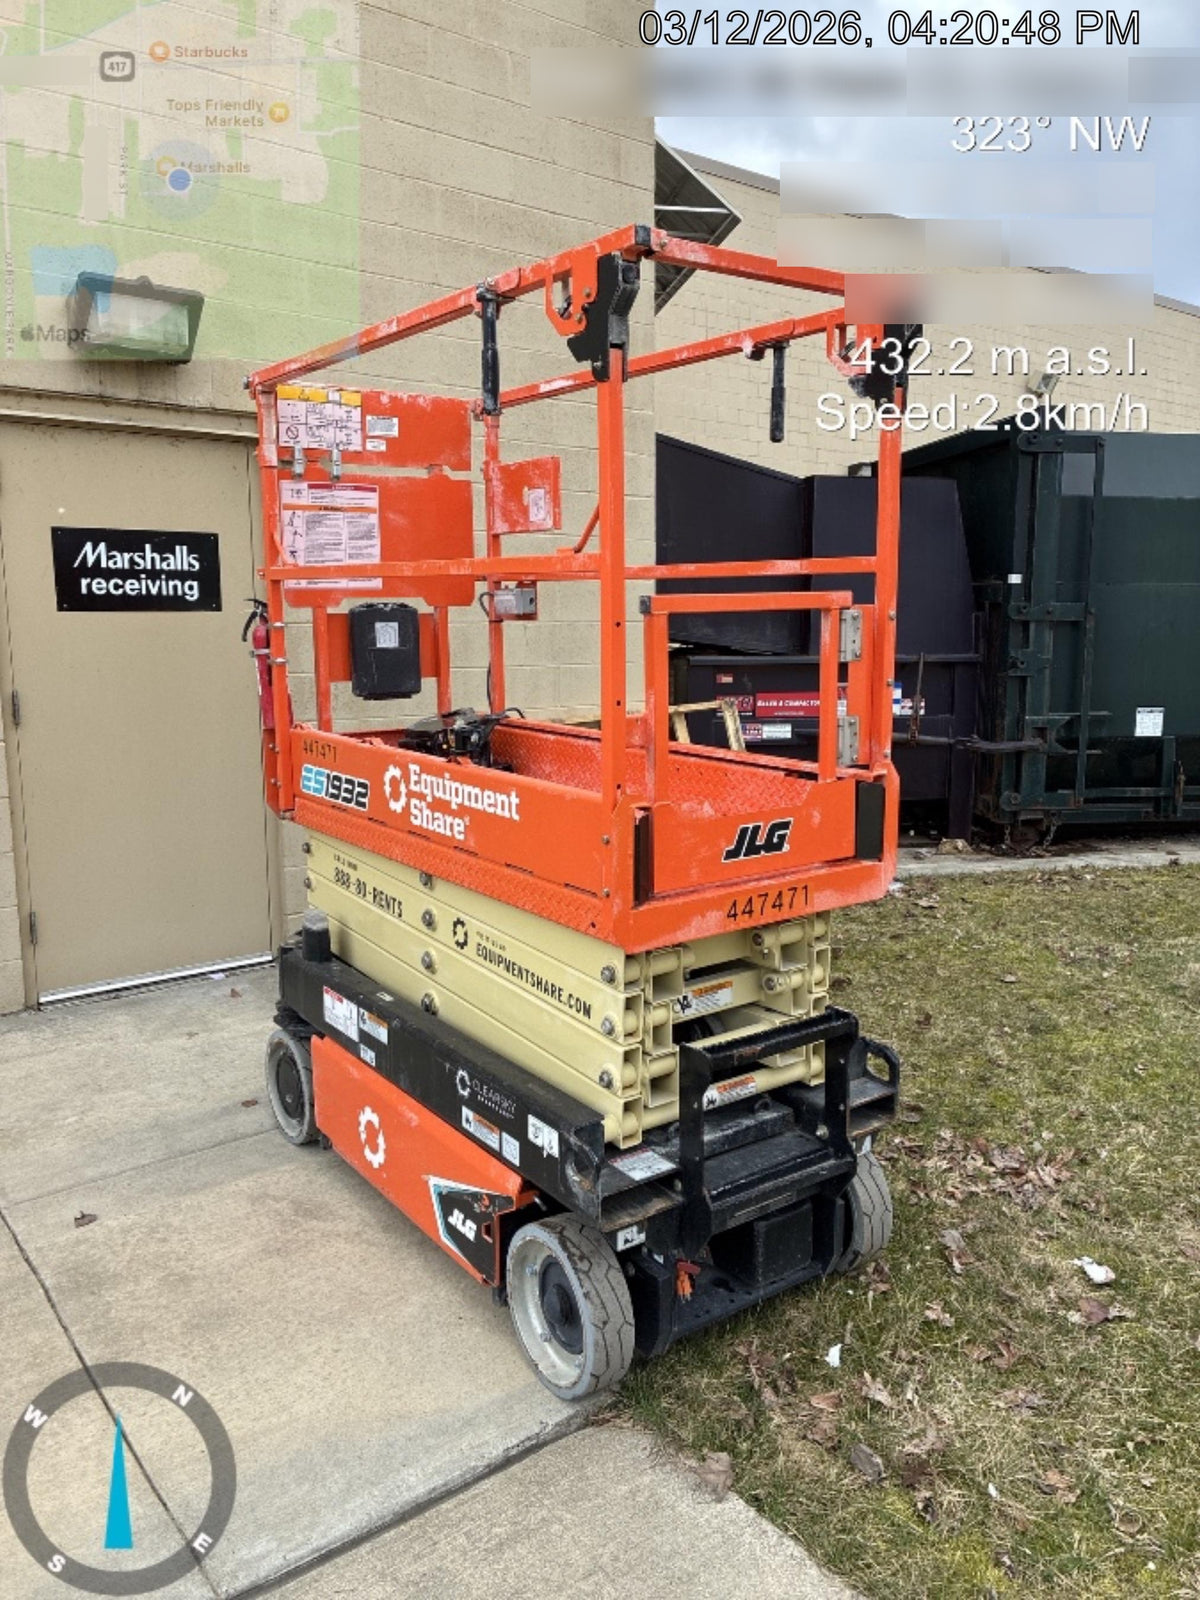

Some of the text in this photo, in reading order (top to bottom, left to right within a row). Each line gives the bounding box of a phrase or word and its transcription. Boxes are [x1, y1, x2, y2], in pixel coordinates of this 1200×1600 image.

[73, 541, 200, 571] Marshalls
[80, 574, 199, 601] receiving
[303, 740, 337, 763] 447471
[301, 765, 369, 811] ES1932
[408, 763, 520, 821] Equipment
[410, 797, 466, 840] Share
[721, 817, 794, 862] JLG
[334, 866, 403, 918] 888-80-RENTS
[727, 884, 808, 921] 447471
[476, 943, 592, 1019] EQUIPMENTSHARE.COM
[447, 1208, 477, 1242] JLG
